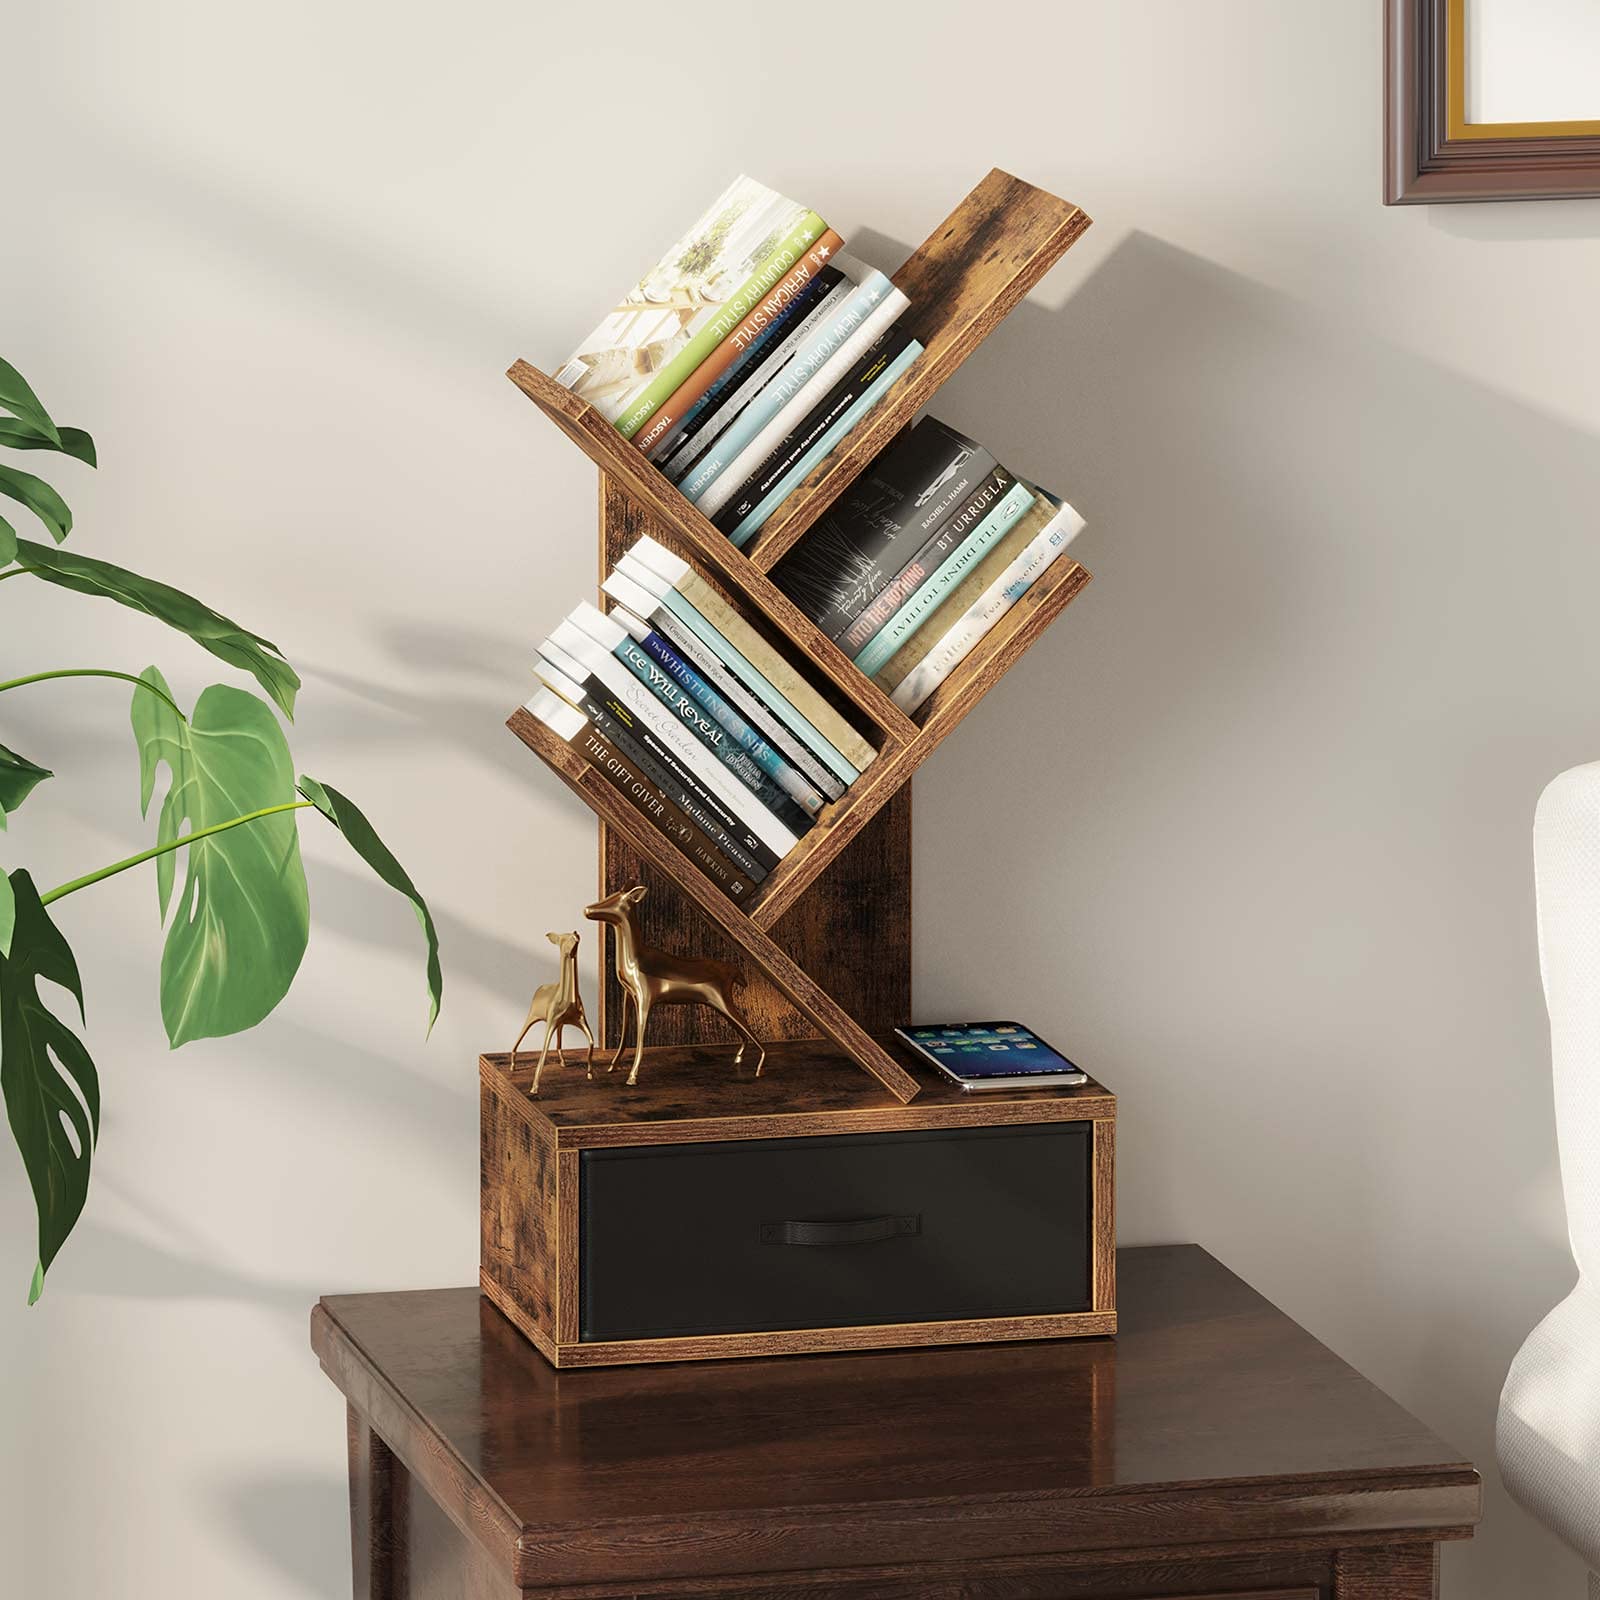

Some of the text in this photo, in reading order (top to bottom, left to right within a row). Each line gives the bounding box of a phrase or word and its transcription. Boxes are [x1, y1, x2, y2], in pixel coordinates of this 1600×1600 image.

[741, 248, 796, 306] COUNTRY
[762, 264, 813, 317] AFRICAN
[709, 299, 748, 340] STYLE
[730, 311, 768, 351] STYLE
[832, 308, 862, 340] NEW
[803, 335, 837, 371] YORK
[771, 366, 809, 406] STYLE
[622, 398, 655, 434] TASCHEN
[638, 414, 672, 451] TASCHEN
[800, 422, 826, 449] Security
[824, 415, 833, 424] of
[789, 447, 802, 461] and
[689, 459, 722, 494] TASCHEN
[759, 459, 791, 492] Insecurity
[921, 503, 945, 529] RACHEL
[948, 478, 969, 501] HAMM
[936, 475, 1008, 551] BT URRUELA
[890, 524, 998, 640] I'LL DRINK TO THAT
[1001, 552, 1046, 600] Nessence
[846, 618, 873, 647] INTO
[866, 598, 892, 627] THE
[883, 562, 926, 607] NOTHING
[627, 688, 696, 760] Secret Garden
[658, 649, 729, 720] WHISTLING
[728, 720, 770, 761] SANDS
[584, 735, 666, 817] THE GIFT GIVER
[643, 734, 666, 757] Spaces
[663, 754, 672, 763] of
[669, 761, 696, 787] Security
[694, 785, 708, 798] and
[705, 796, 736, 827] Insecurity
[678, 794, 719, 834] Madame
[717, 833, 754, 869] Picasso
[695, 846, 729, 880] HAWKINS
